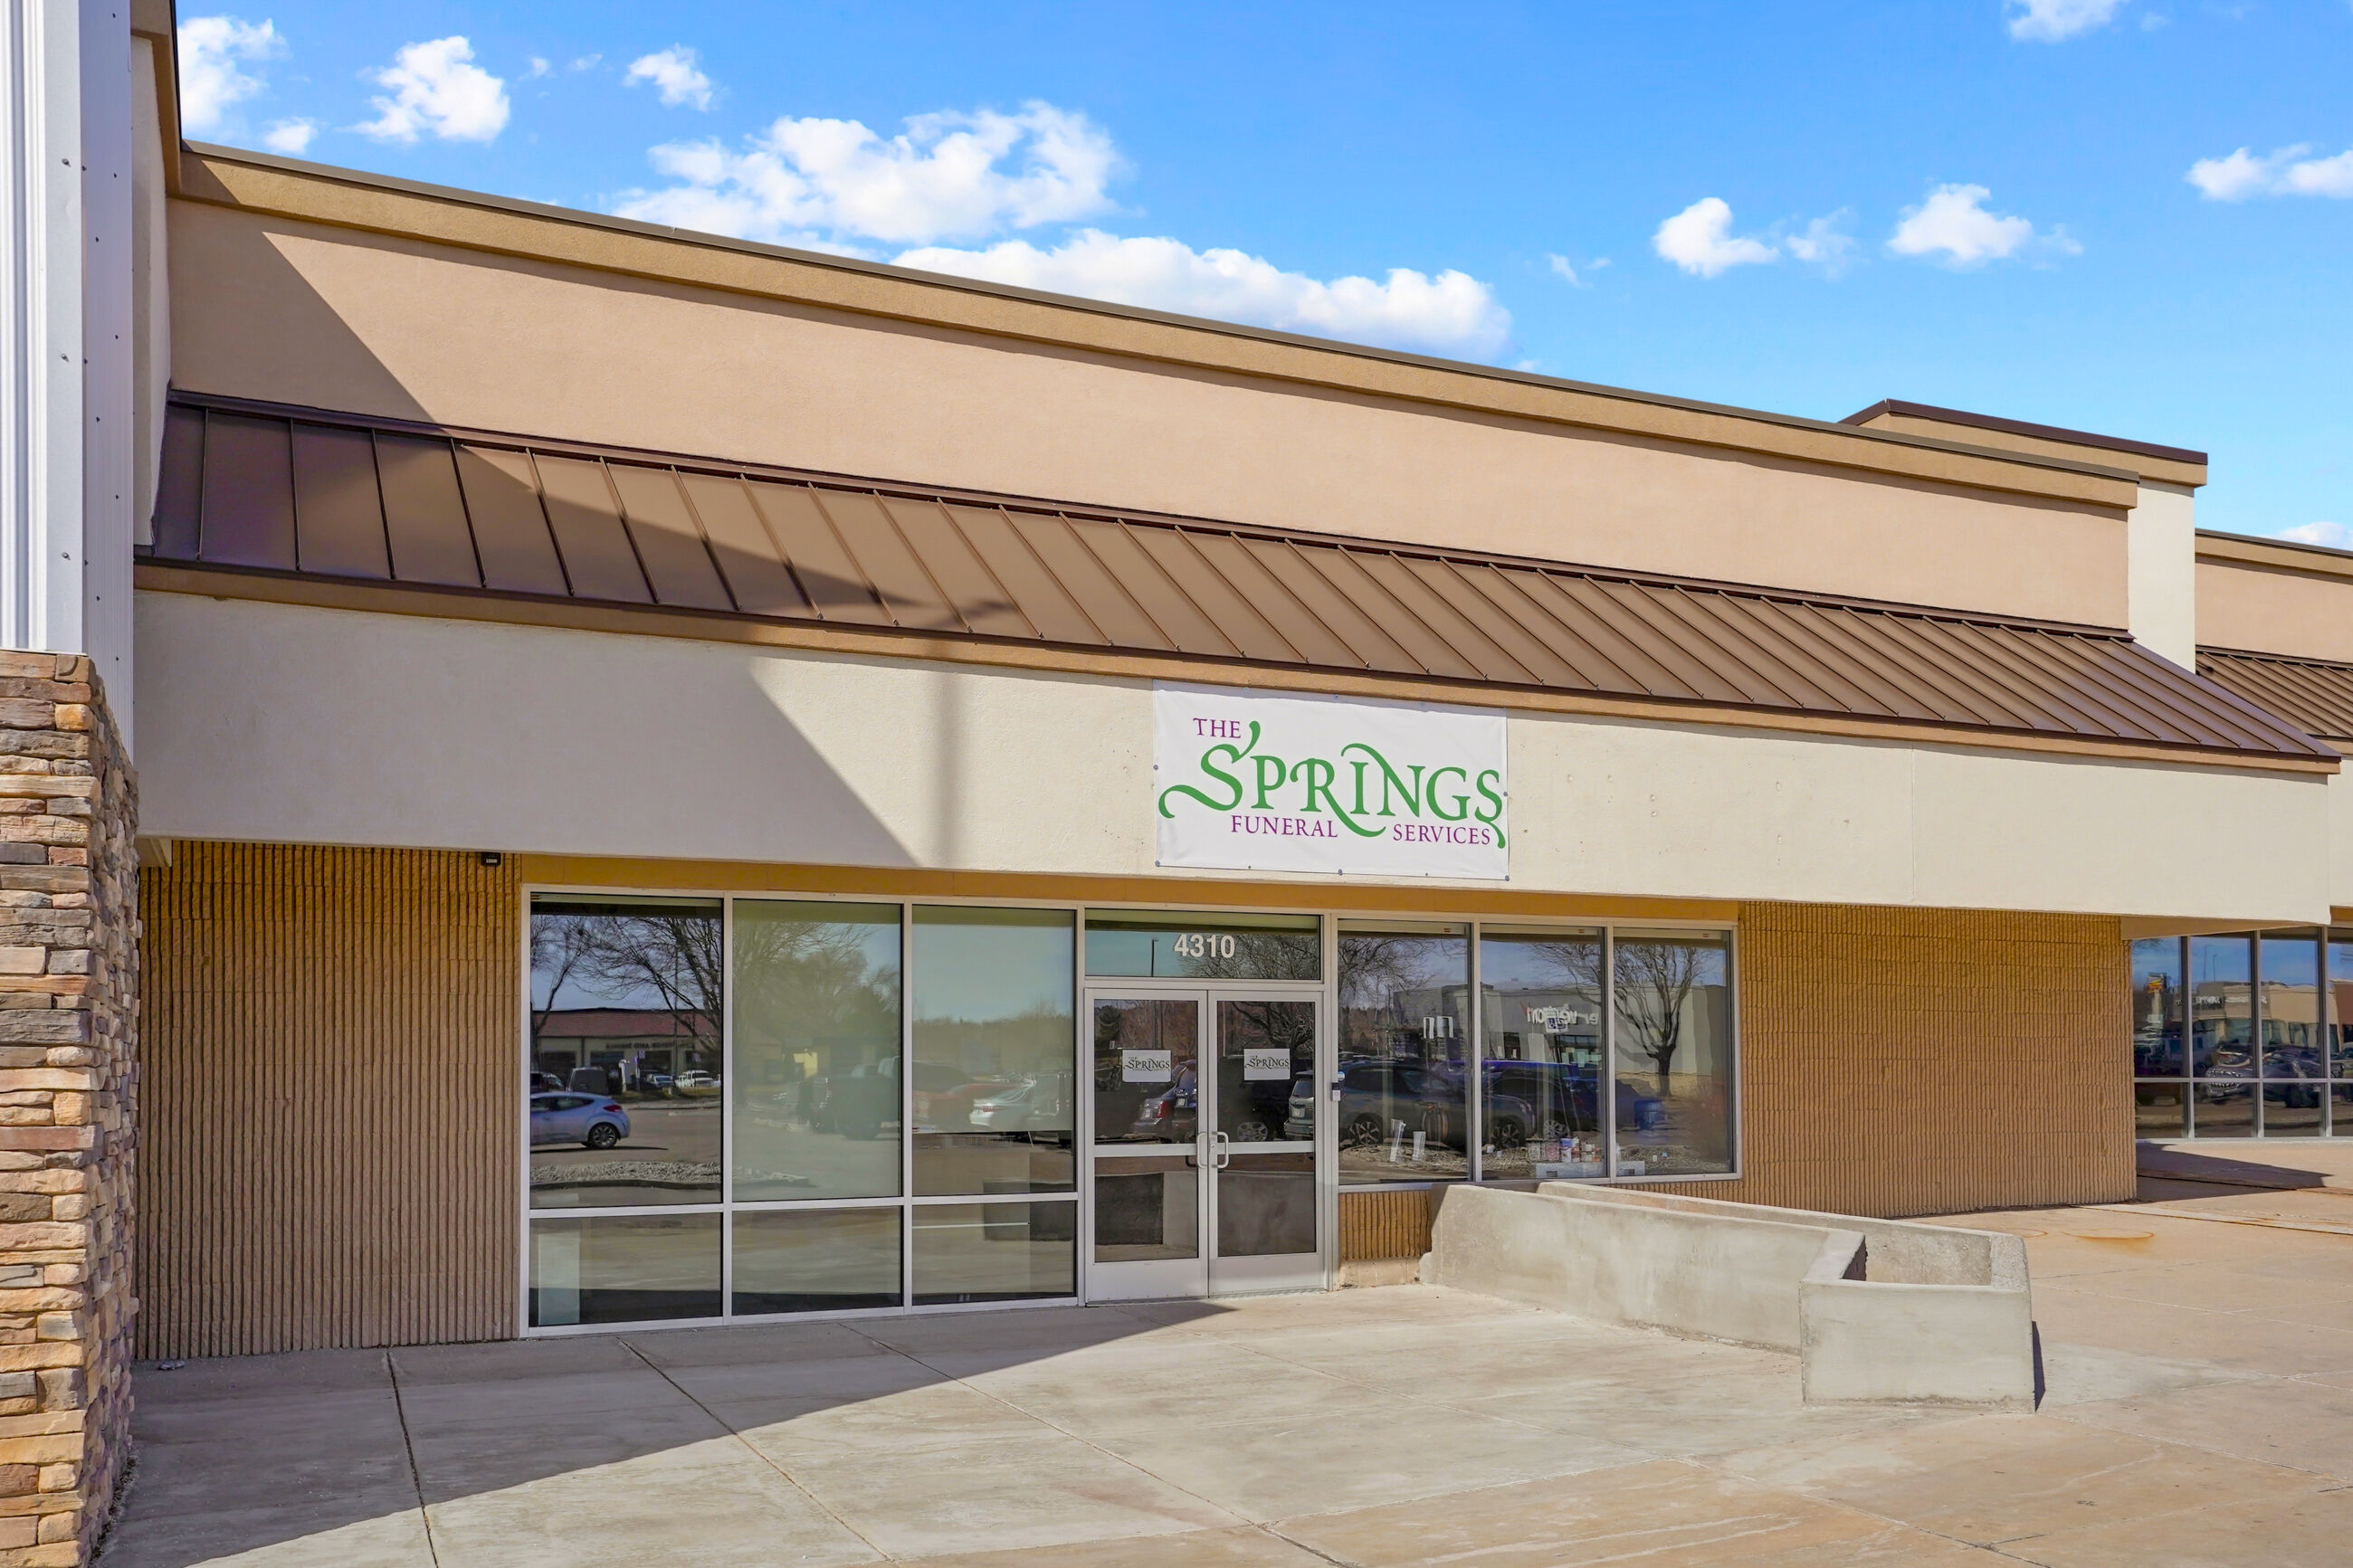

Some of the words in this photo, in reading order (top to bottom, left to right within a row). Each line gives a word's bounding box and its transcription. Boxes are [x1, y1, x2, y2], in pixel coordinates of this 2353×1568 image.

[1193, 717, 1241, 739] THE
[1158, 720, 1506, 849] SPRINGS
[1231, 815, 1338, 838] FUNERAL
[1393, 824, 1491, 845] SERVICES
[1174, 934, 1235, 958] 4310
[1123, 1056, 1170, 1071] SPRINGS
[1244, 1055, 1289, 1069] SPRINGS
